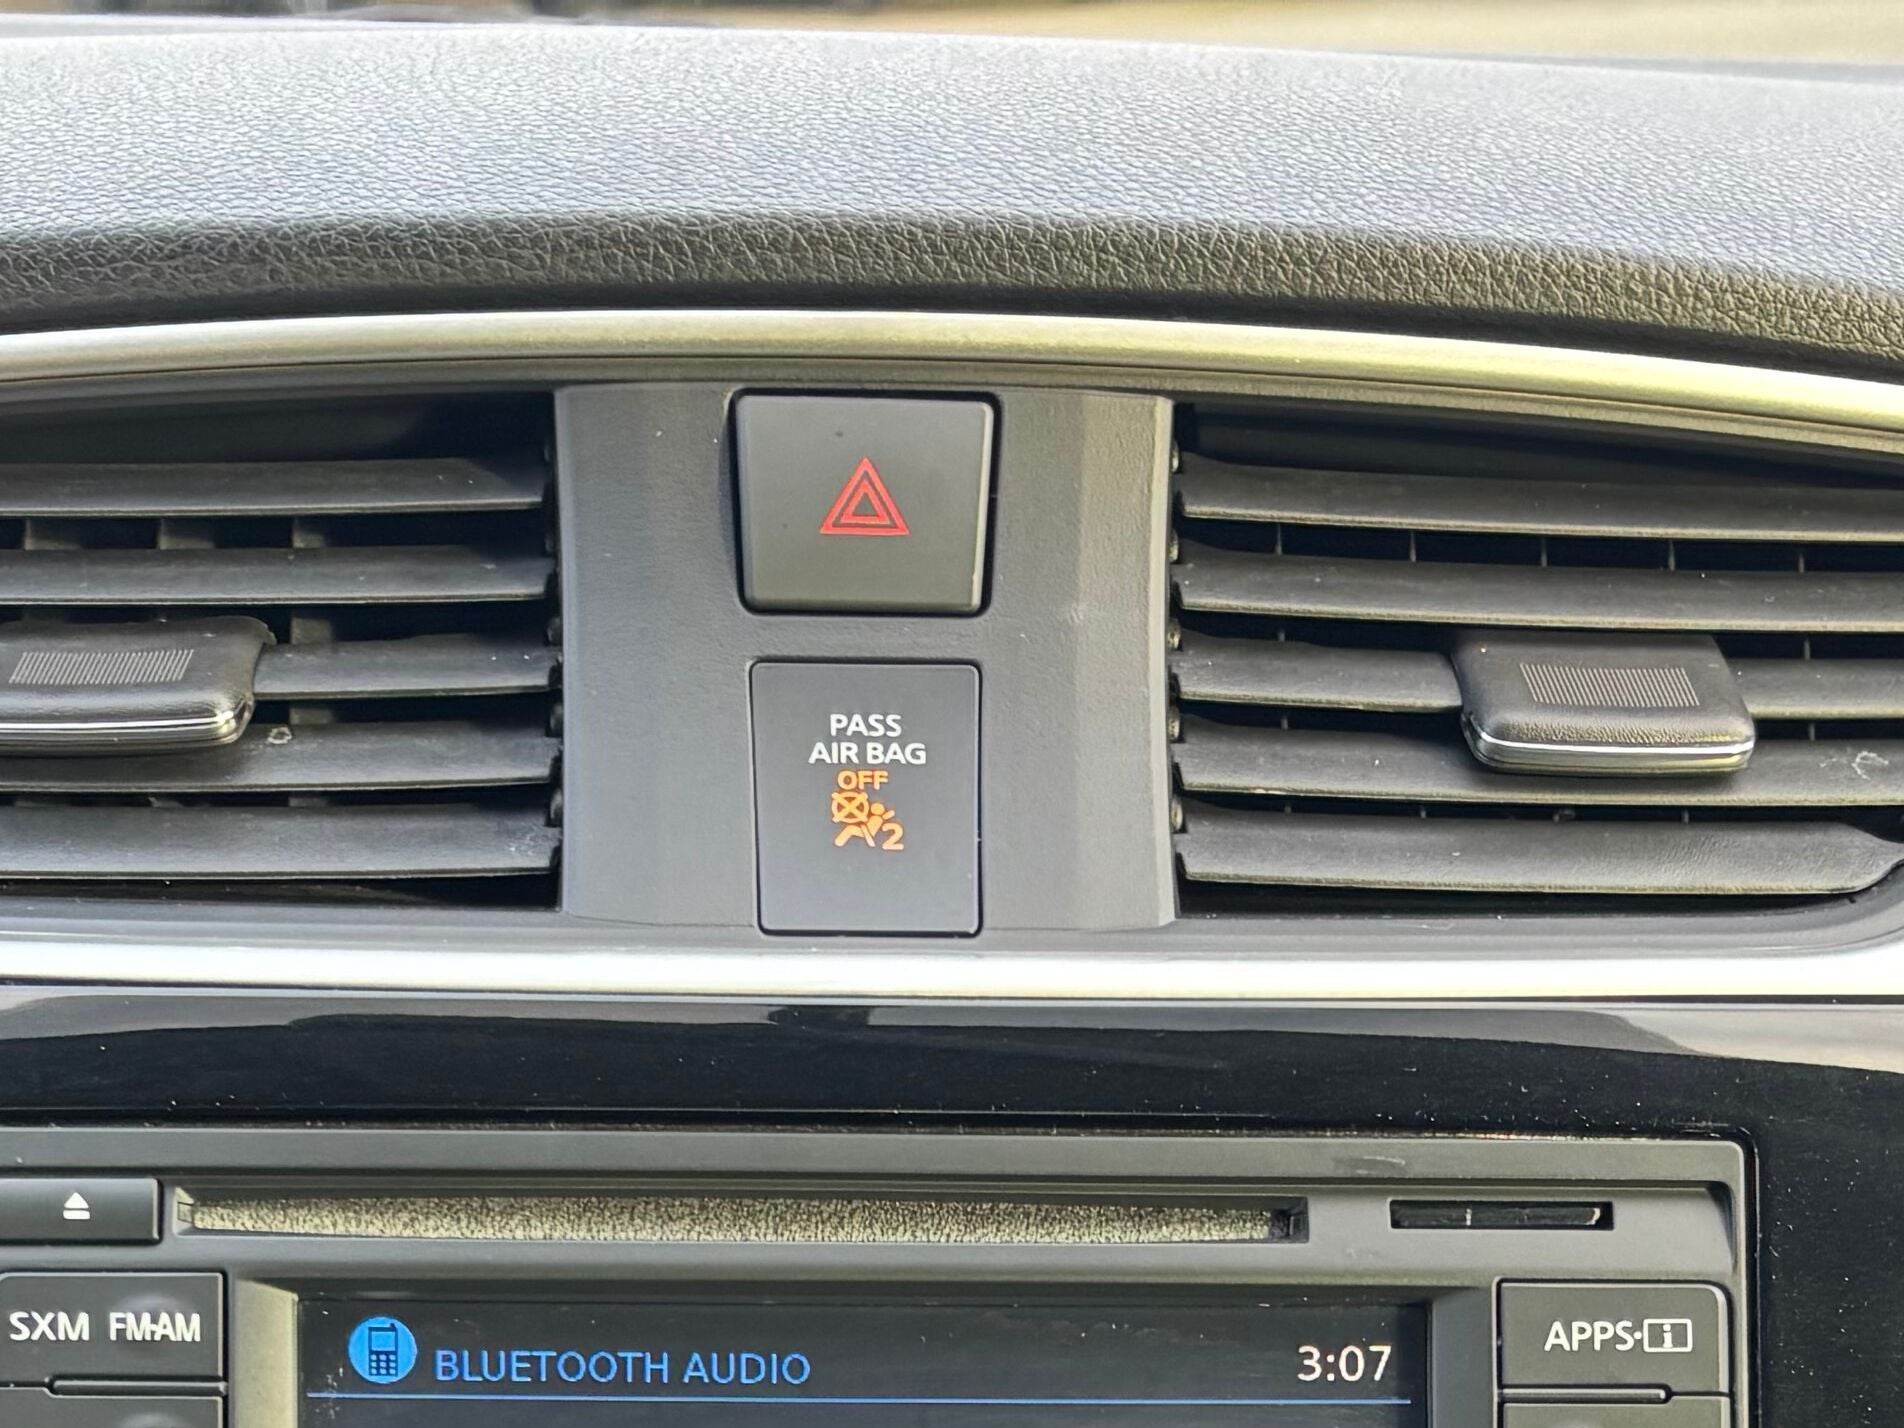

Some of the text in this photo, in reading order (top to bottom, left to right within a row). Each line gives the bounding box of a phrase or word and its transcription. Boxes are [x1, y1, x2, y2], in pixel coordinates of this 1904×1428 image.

[830, 713, 902, 738] PASS
[809, 742, 927, 765] AIR BAG
[837, 770, 889, 790] OFF
[9, 1311, 90, 1341] SXM
[435, 1349, 811, 1385] BLUETOOTH AUDIO
[1297, 1345, 1392, 1382] 3:07
